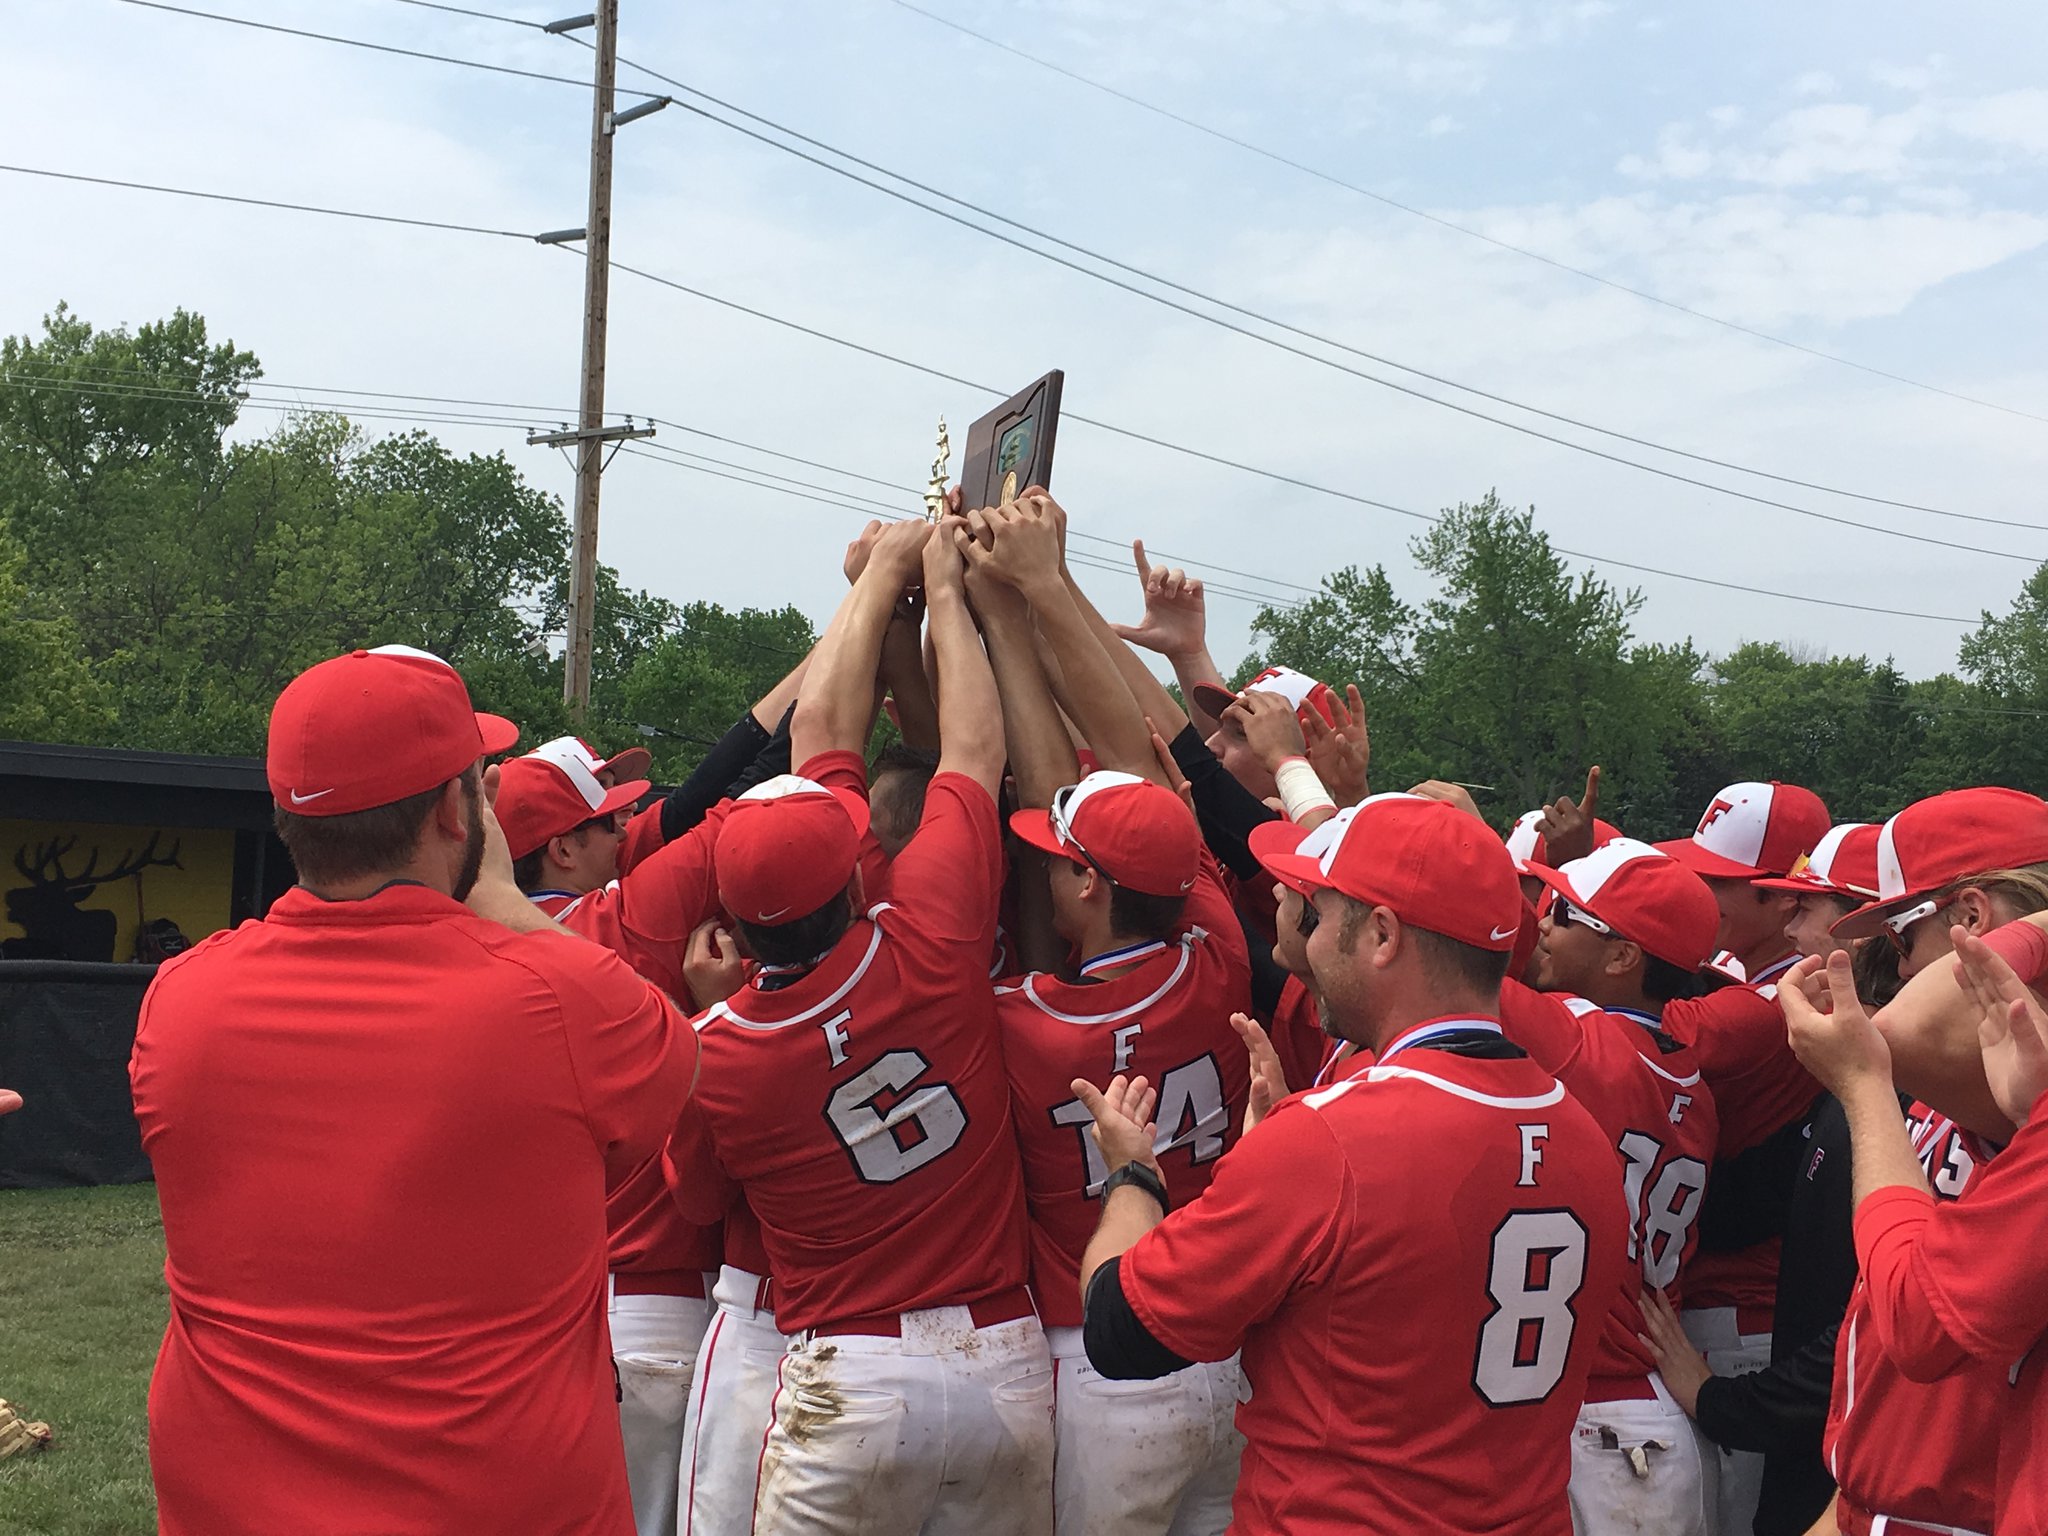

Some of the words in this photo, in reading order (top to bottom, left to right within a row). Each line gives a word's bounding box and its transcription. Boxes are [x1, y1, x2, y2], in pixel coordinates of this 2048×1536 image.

[1697, 798, 1733, 835] F
[820, 1008, 852, 1070] F
[1110, 1022, 1142, 1075] F
[822, 1048, 970, 1184] 6
[1049, 1051, 1230, 1199] 14
[1516, 1123, 1549, 1186] F
[1618, 1129, 1708, 1290] 18
[1471, 1207, 1589, 1408] 8
